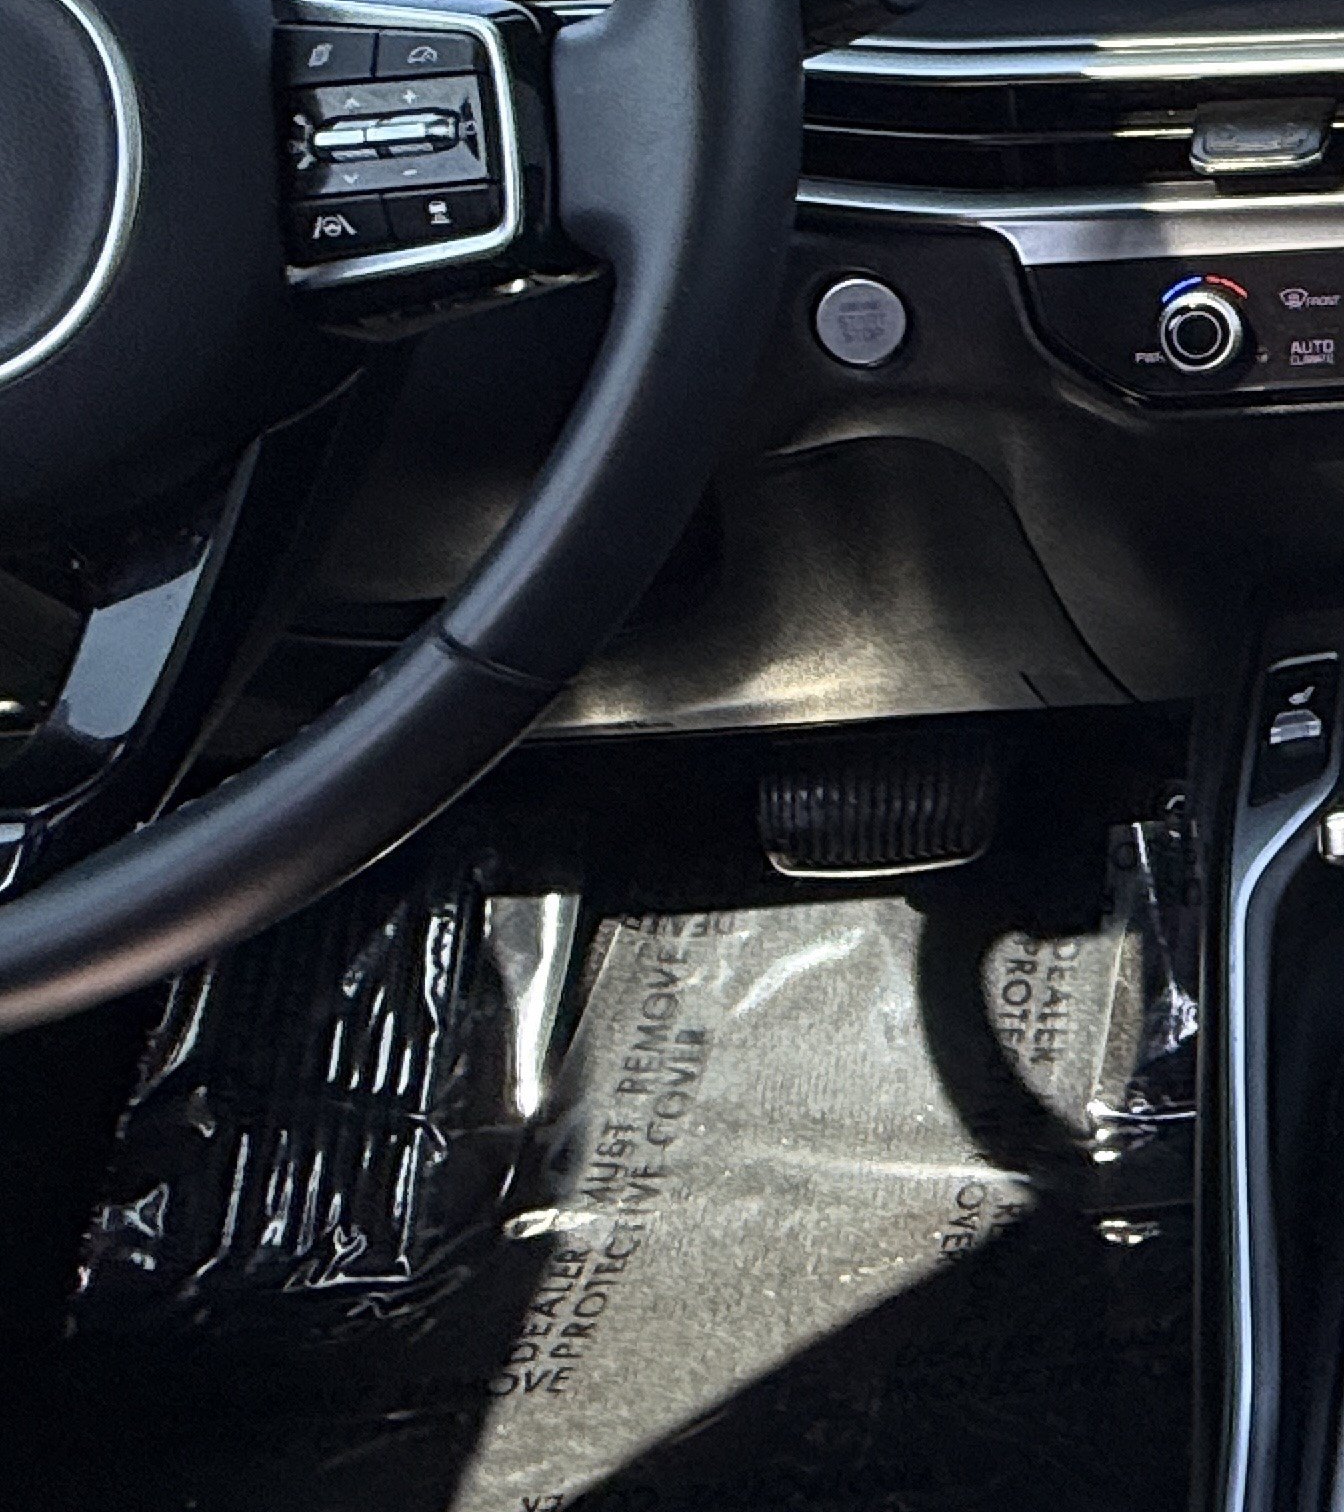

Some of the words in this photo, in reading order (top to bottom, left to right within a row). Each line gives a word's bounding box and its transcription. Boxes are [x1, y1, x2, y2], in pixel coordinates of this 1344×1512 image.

[1290, 339, 1335, 355] AUTO
[507, 1247, 590, 1365] DEALER
[616, 940, 688, 1096] REMOVE
